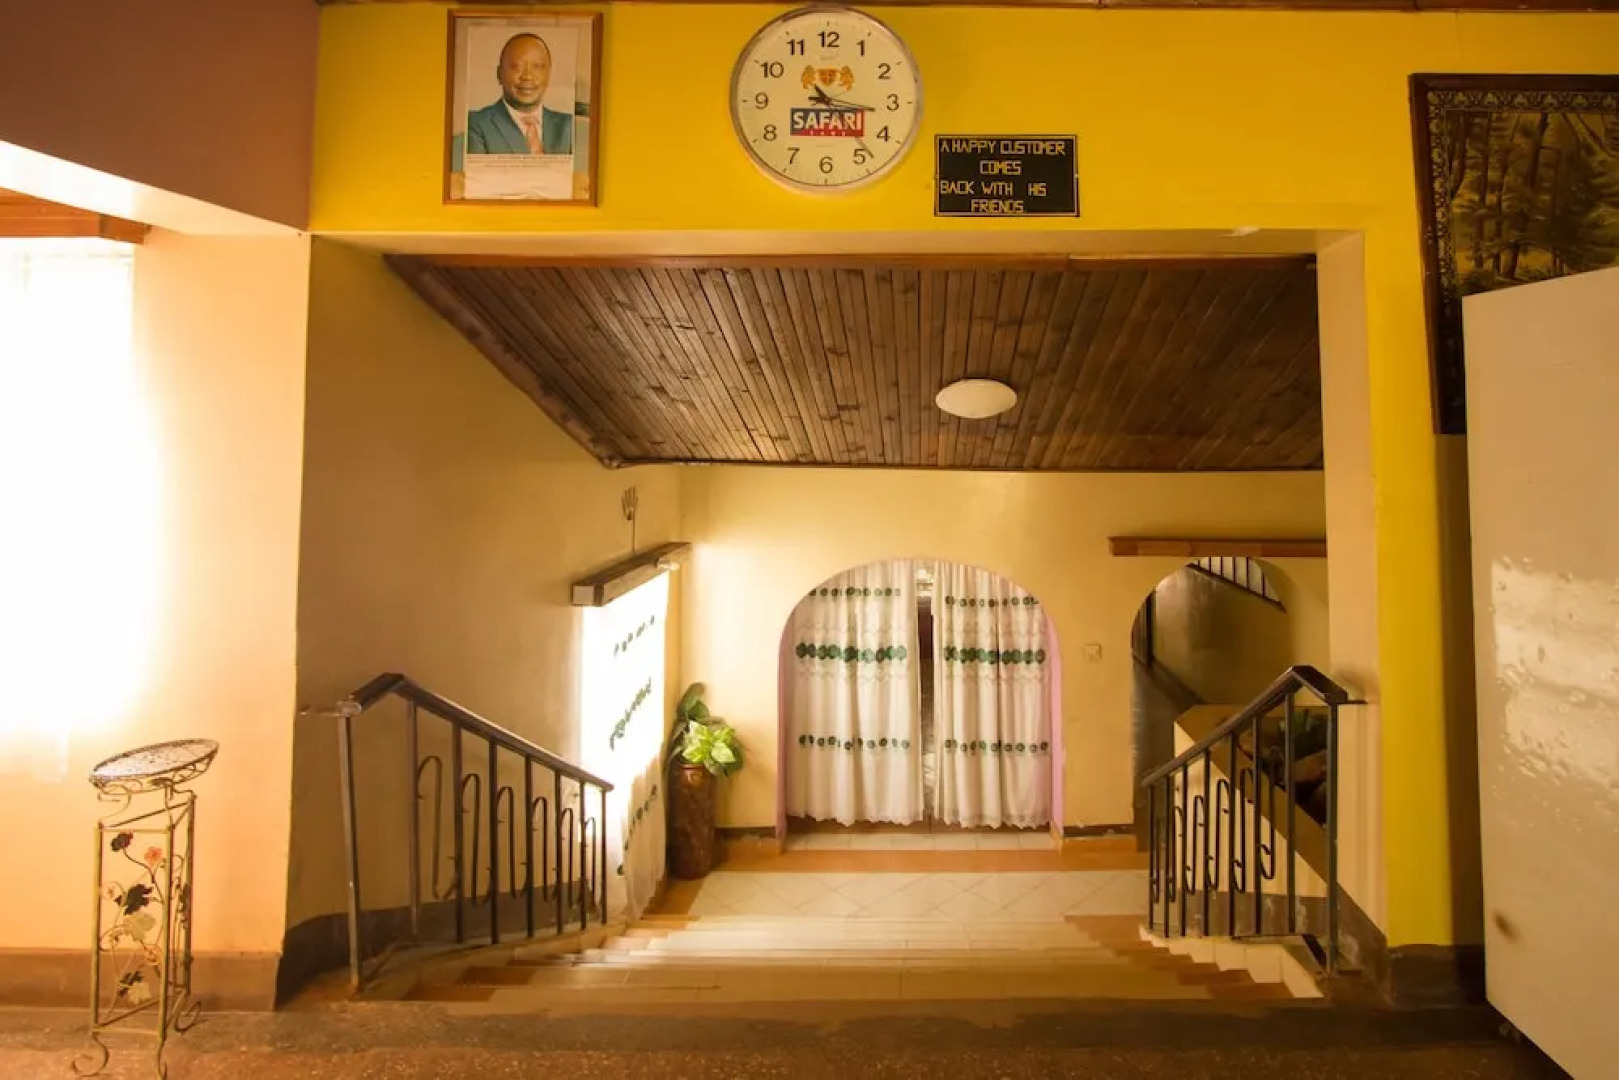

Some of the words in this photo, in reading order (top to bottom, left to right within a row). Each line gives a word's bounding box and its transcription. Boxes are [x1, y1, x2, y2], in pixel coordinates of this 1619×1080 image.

[787, 39, 805, 55] 11
[818, 31, 840, 48] 12
[857, 40, 865, 57] 1
[761, 61, 784, 78] 10
[878, 63, 891, 80] 2
[755, 92, 769, 110] 9
[886, 94, 899, 111] 3
[792, 111, 862, 130] SAFARI
[763, 124, 777, 141] 8
[876, 126, 890, 142] 4
[787, 147, 799, 164] 7
[941, 140, 950, 153] A
[952, 139, 996, 154] HAPPY
[1000, 140, 1065, 155] CUSTOMER
[819, 156, 833, 173] 6
[853, 148, 866, 165] 5
[980, 160, 1022, 175] COMES
[940, 180, 975, 194] BACK
[981, 181, 1013, 195] WITH
[1028, 182, 1047, 197] HIS
[971, 199, 1024, 213] FRIENDS
